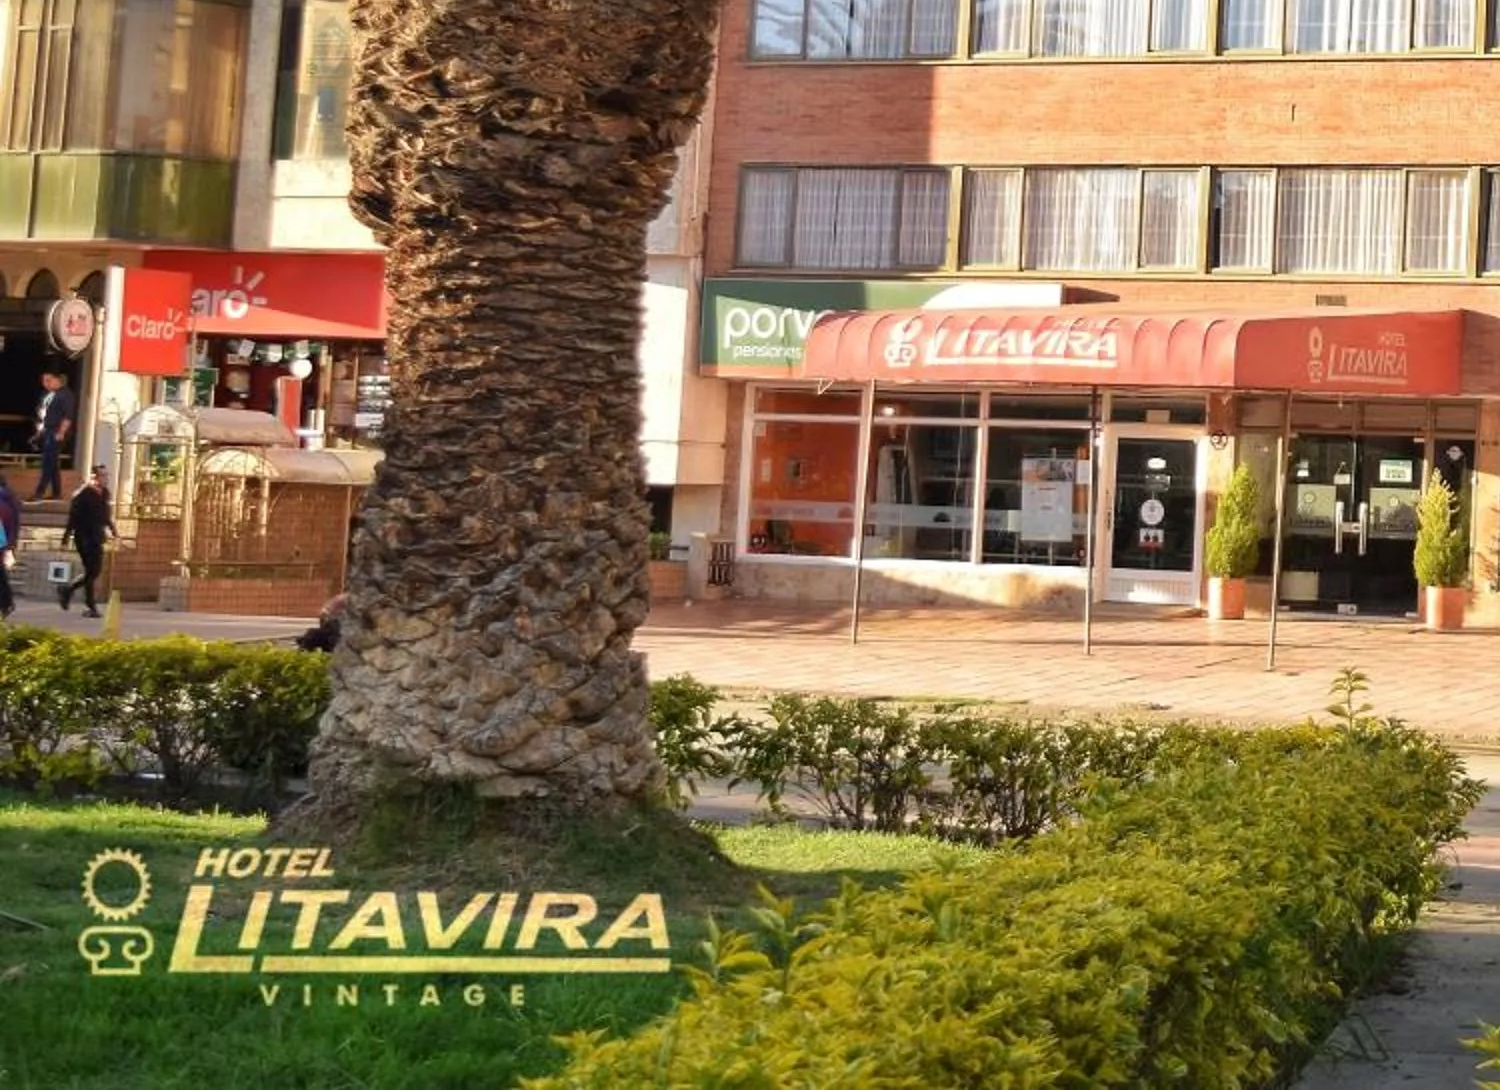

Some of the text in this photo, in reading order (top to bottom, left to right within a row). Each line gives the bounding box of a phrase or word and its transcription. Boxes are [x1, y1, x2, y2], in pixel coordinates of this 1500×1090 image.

[191, 287, 248, 319] aro
[127, 314, 176, 340] Claro
[723, 307, 837, 349] porv
[924, 326, 1118, 368] LITAVIRA
[1326, 343, 1408, 385] LITAVIRA
